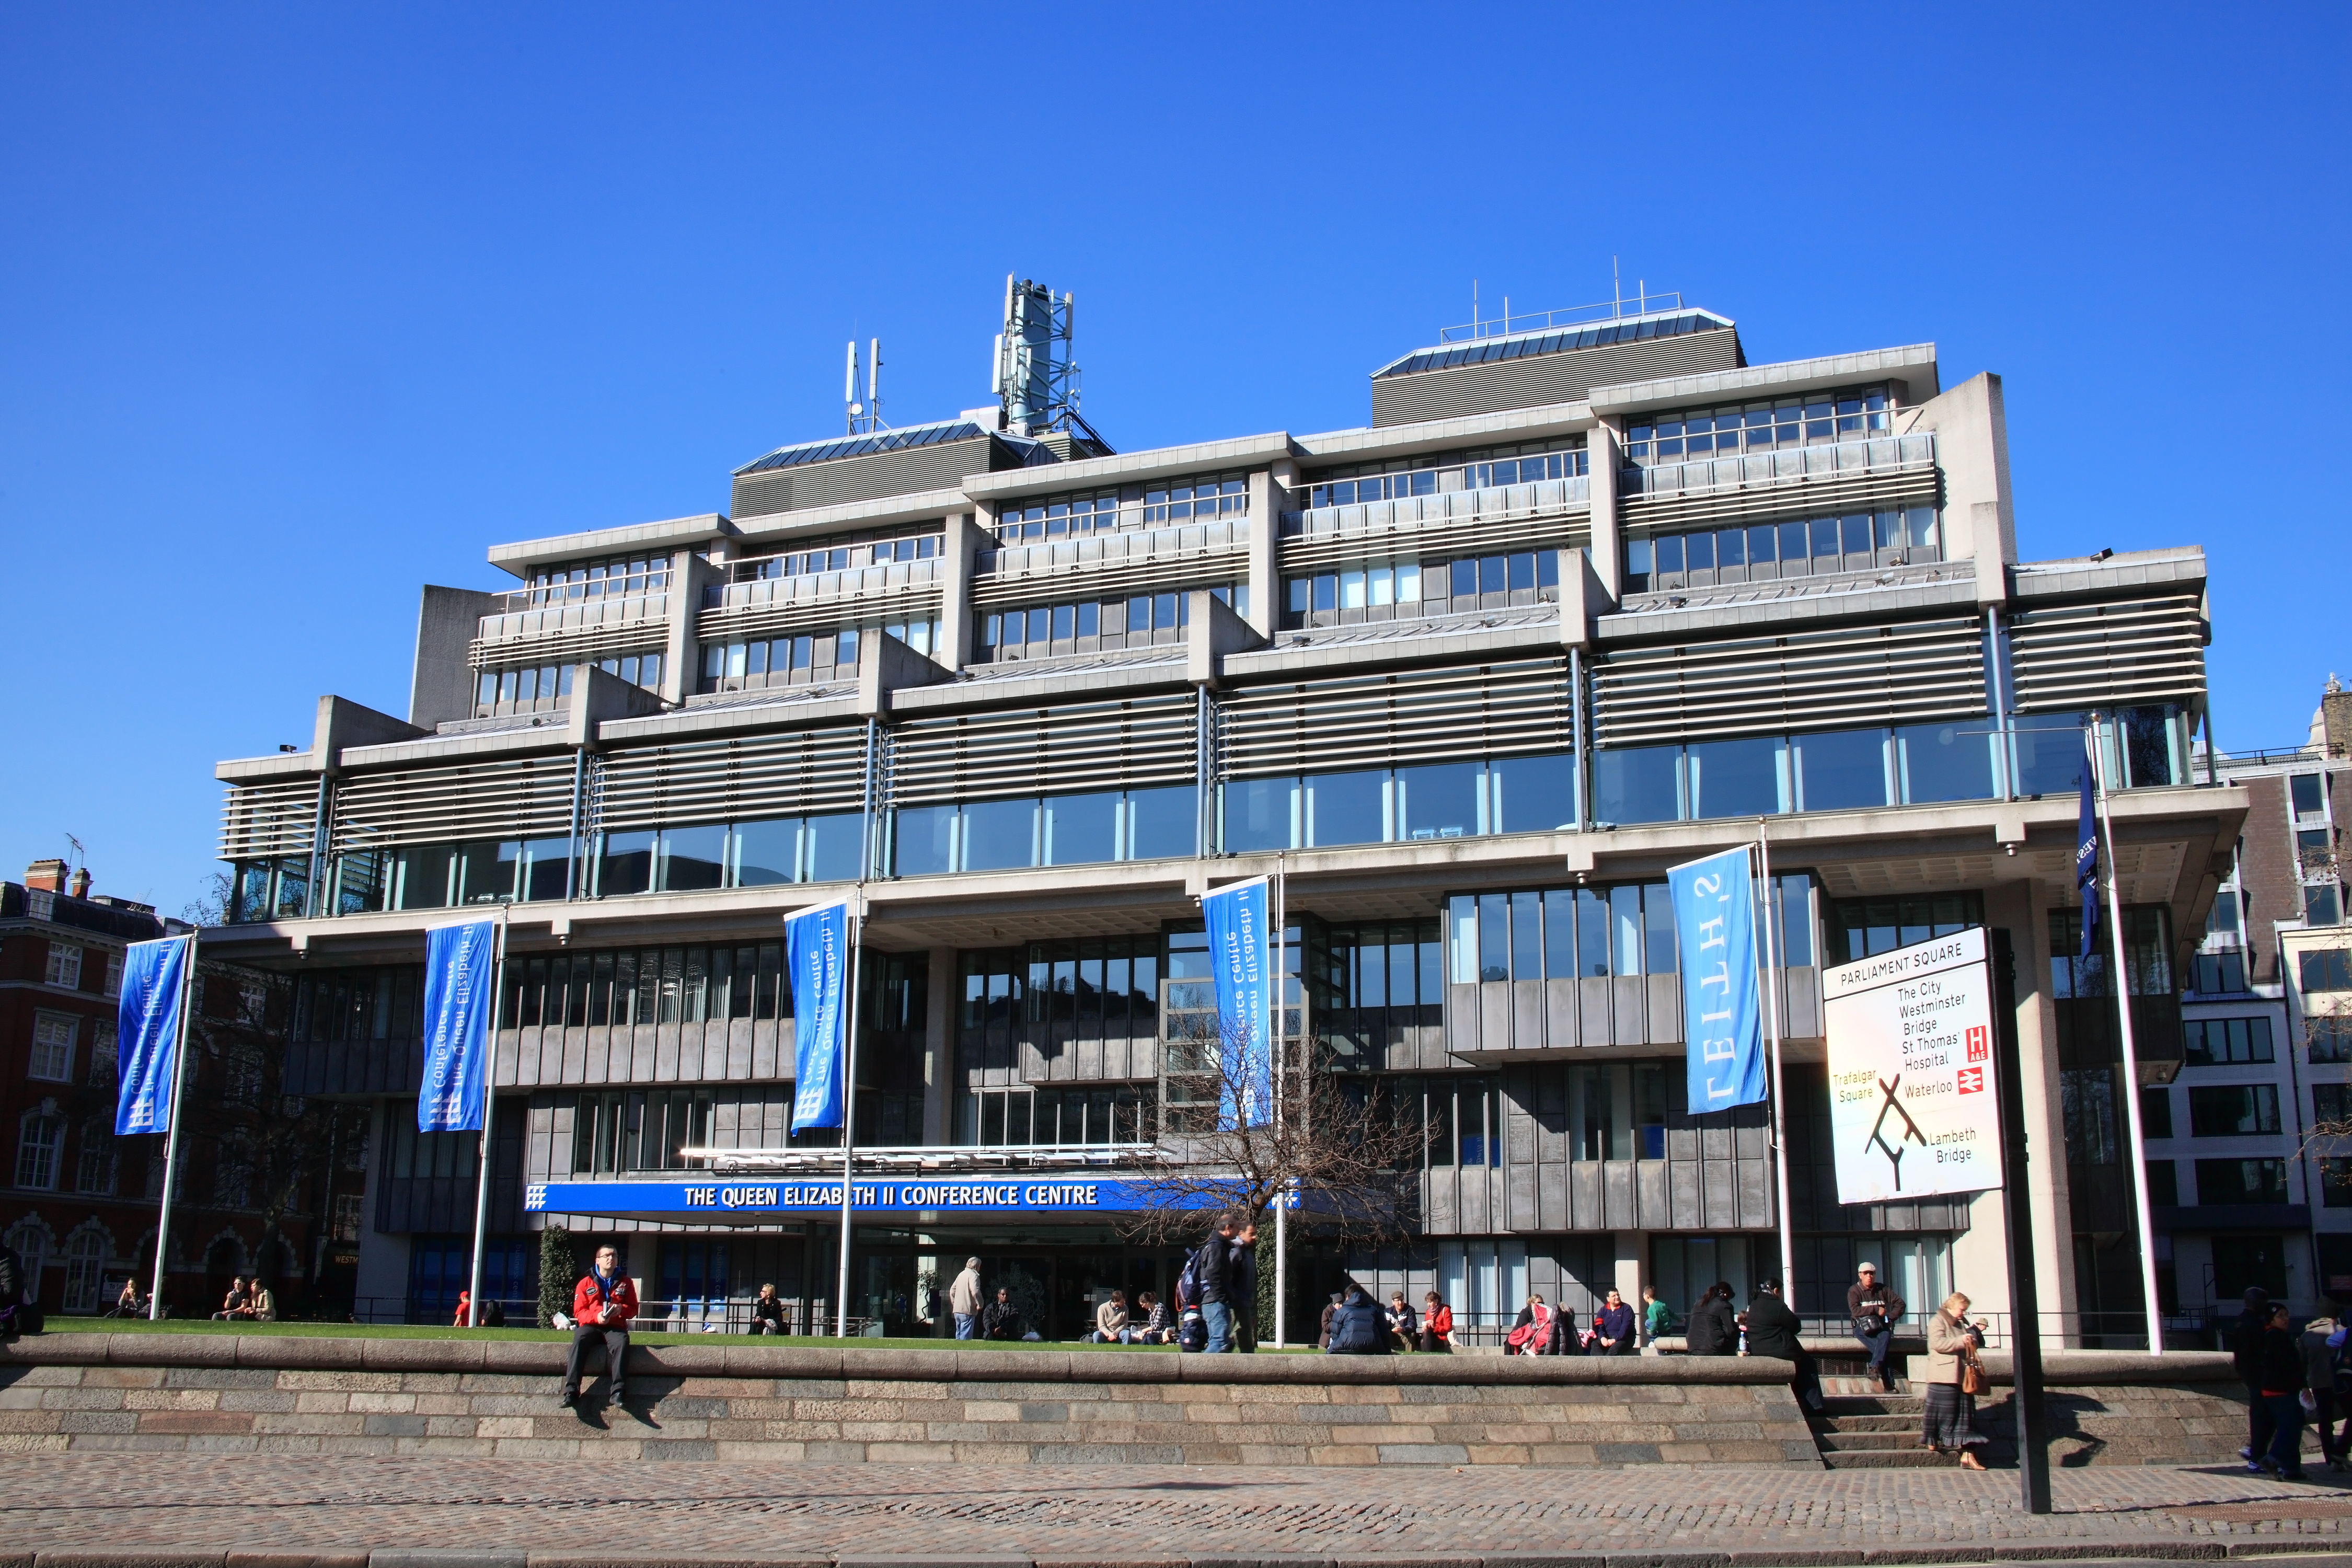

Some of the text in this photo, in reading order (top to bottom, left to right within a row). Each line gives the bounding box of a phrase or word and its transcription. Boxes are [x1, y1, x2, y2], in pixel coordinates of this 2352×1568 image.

[1841, 942, 1962, 986] PARLIAMENT SQUARE
[1898, 981, 1941, 1001] The City
[1899, 994, 1966, 1019] Westminster
[1904, 1019, 1937, 1035] Bridge
[1903, 1032, 1960, 1054] St Thomas'
[1905, 1051, 1949, 1071] Hospital
[1970, 1051, 1986, 1062] A&E
[1834, 1069, 1876, 1087] Trafalgar
[1839, 1088, 1873, 1103] Square
[1905, 1080, 1952, 1098] Waterloo
[1930, 1127, 1976, 1146] Lambeth
[1936, 1149, 1971, 1163] Bridge
[684, 1185, 1097, 1207] THE QUEEN ELIZABTH II CONFERENCE CENTRE
[513, 1244, 523, 1279] business
